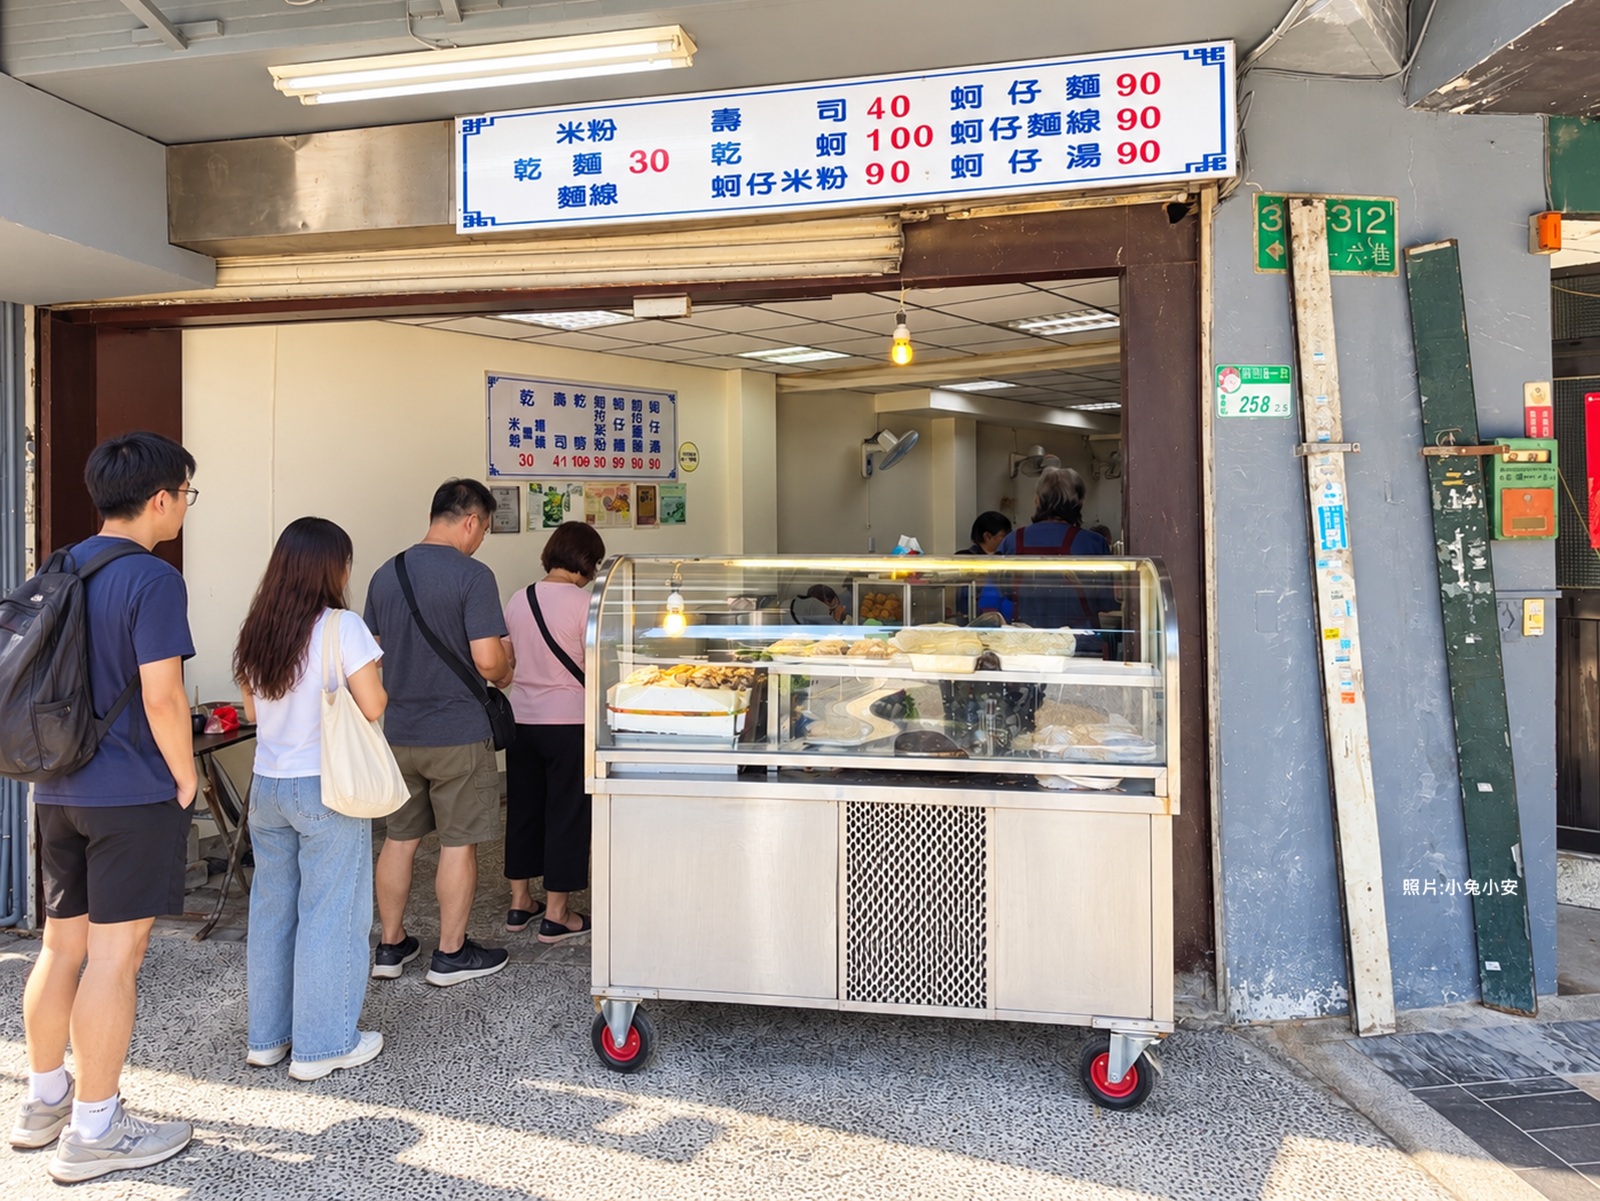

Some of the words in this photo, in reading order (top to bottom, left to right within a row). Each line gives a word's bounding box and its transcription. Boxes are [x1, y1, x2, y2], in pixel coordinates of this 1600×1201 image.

[1116, 71, 1162, 97] 90
[866, 94, 911, 120] 40
[556, 118, 618, 145] 米粉
[866, 124, 934, 151] 100
[950, 108, 1102, 145] 蚵仔麵線
[1116, 106, 1162, 131] 90
[513, 157, 543, 182] 乾
[572, 151, 603, 177] 麵
[629, 148, 670, 175] 30
[1116, 139, 1161, 165] 90
[711, 165, 849, 199] 蚵仔米粉
[864, 160, 911, 185] 90
[557, 182, 619, 209] 麵線
[1331, 204, 1386, 234] 312
[1239, 395, 1271, 413] 258
[518, 453, 534, 467] 30
